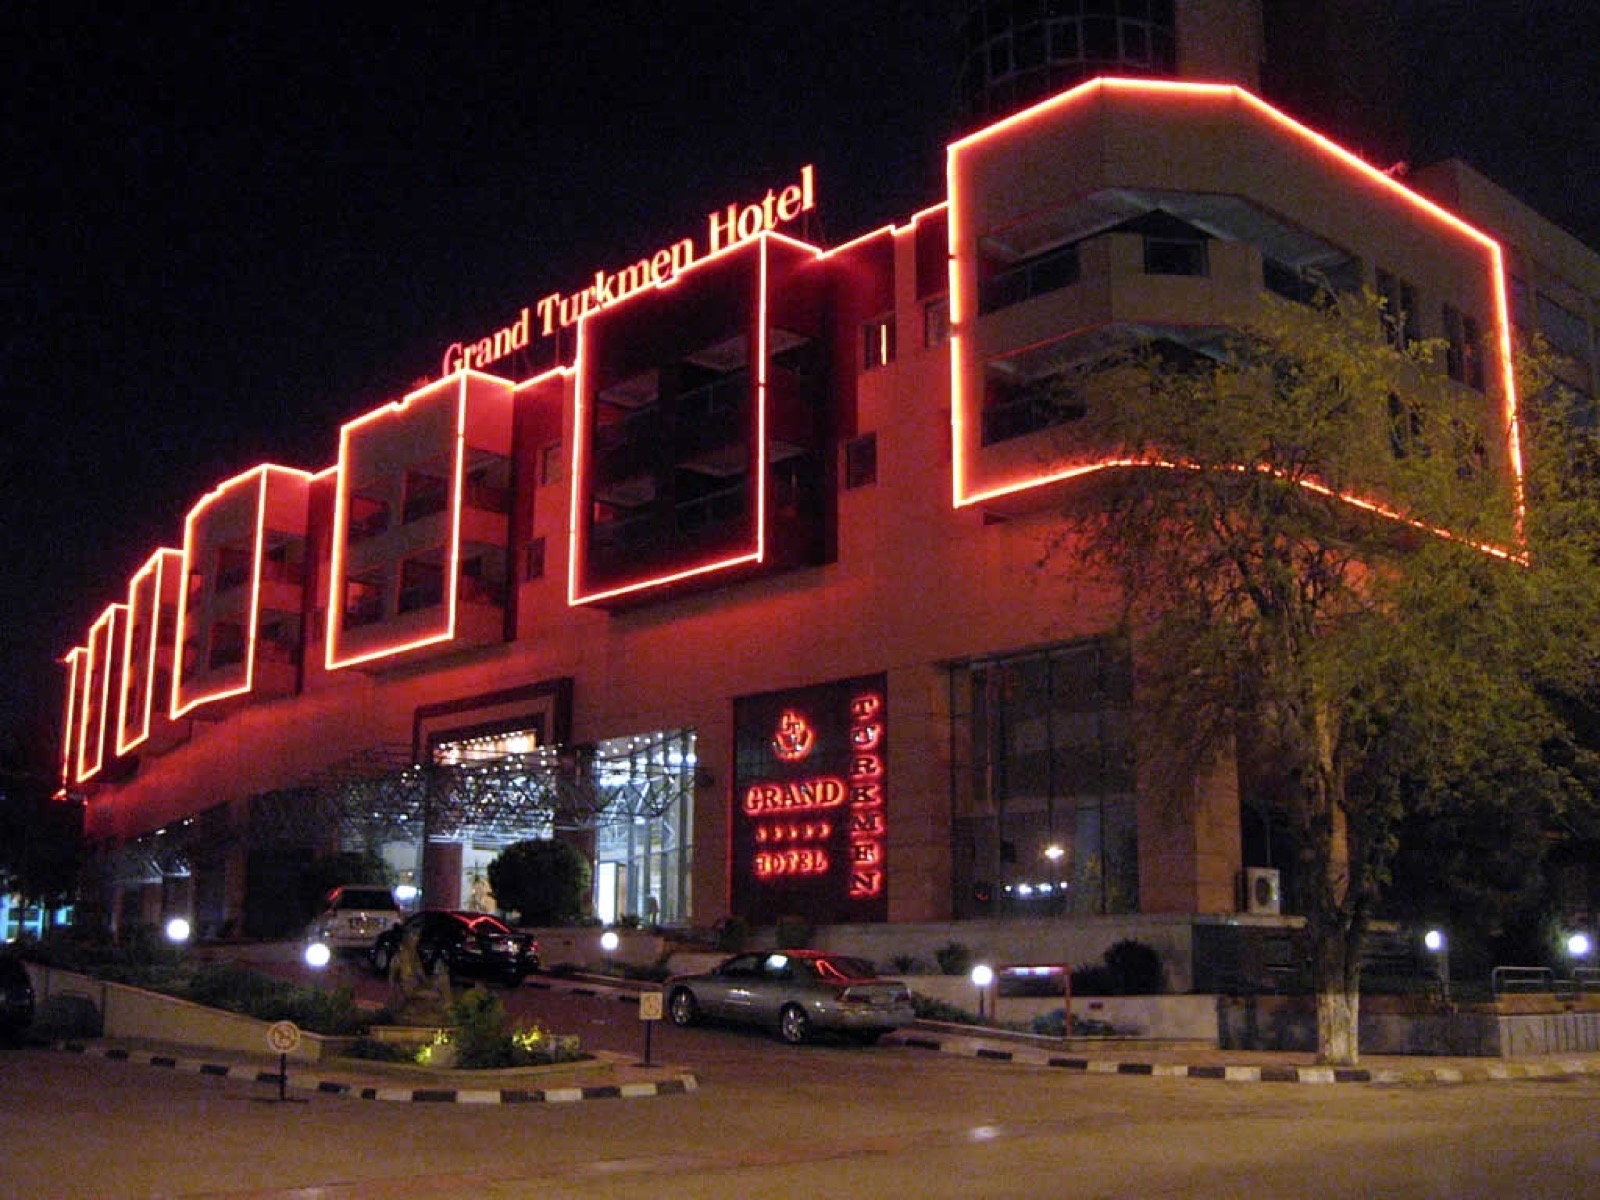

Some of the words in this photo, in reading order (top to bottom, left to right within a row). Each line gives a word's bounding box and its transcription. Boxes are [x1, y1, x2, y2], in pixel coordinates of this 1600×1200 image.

[443, 307, 529, 376] Grand
[537, 238, 694, 336] Turkmen
[708, 164, 815, 255] Hotel
[745, 778, 845, 815] GRAND
[850, 692, 884, 897] TURKMEN
[755, 850, 829, 878] HOTEL
